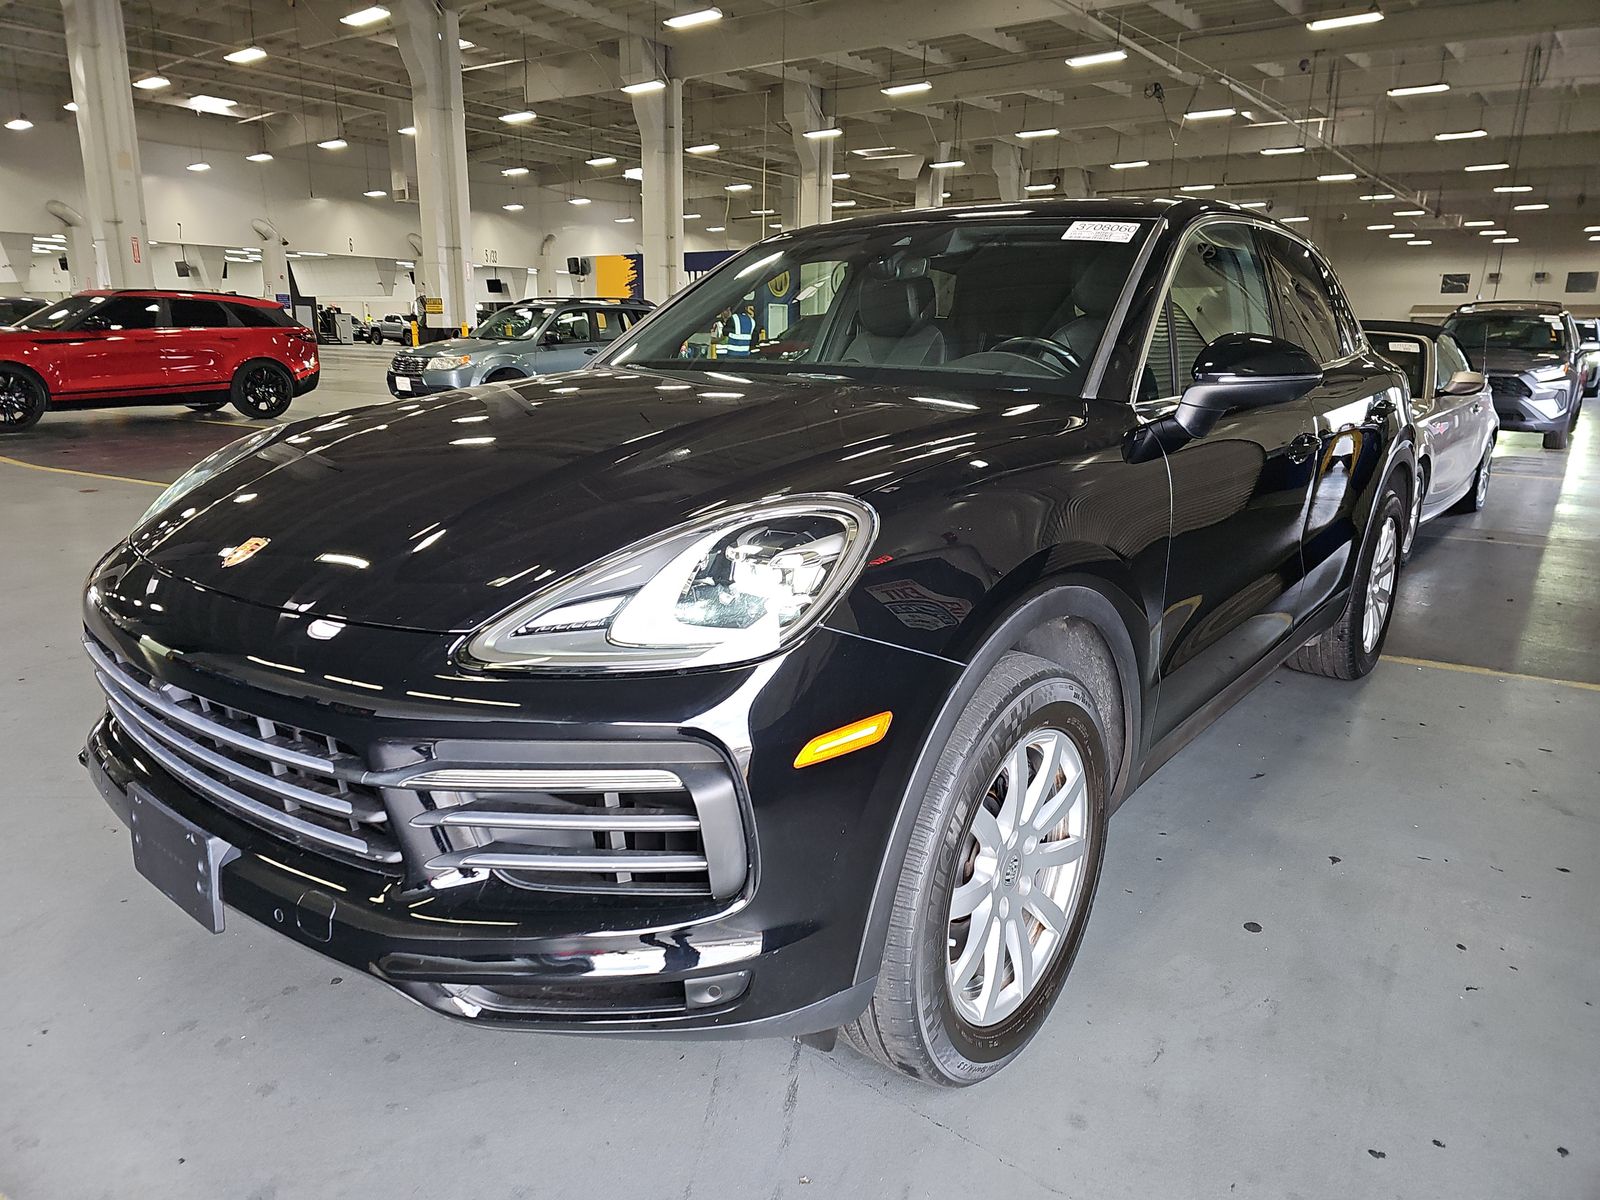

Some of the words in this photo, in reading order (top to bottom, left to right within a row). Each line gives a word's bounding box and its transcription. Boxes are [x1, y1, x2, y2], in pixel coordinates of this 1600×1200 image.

[1076, 223, 1138, 233] 3708060
[348, 237, 354, 253] 6
[928, 738, 1001, 924] MICHELIN
